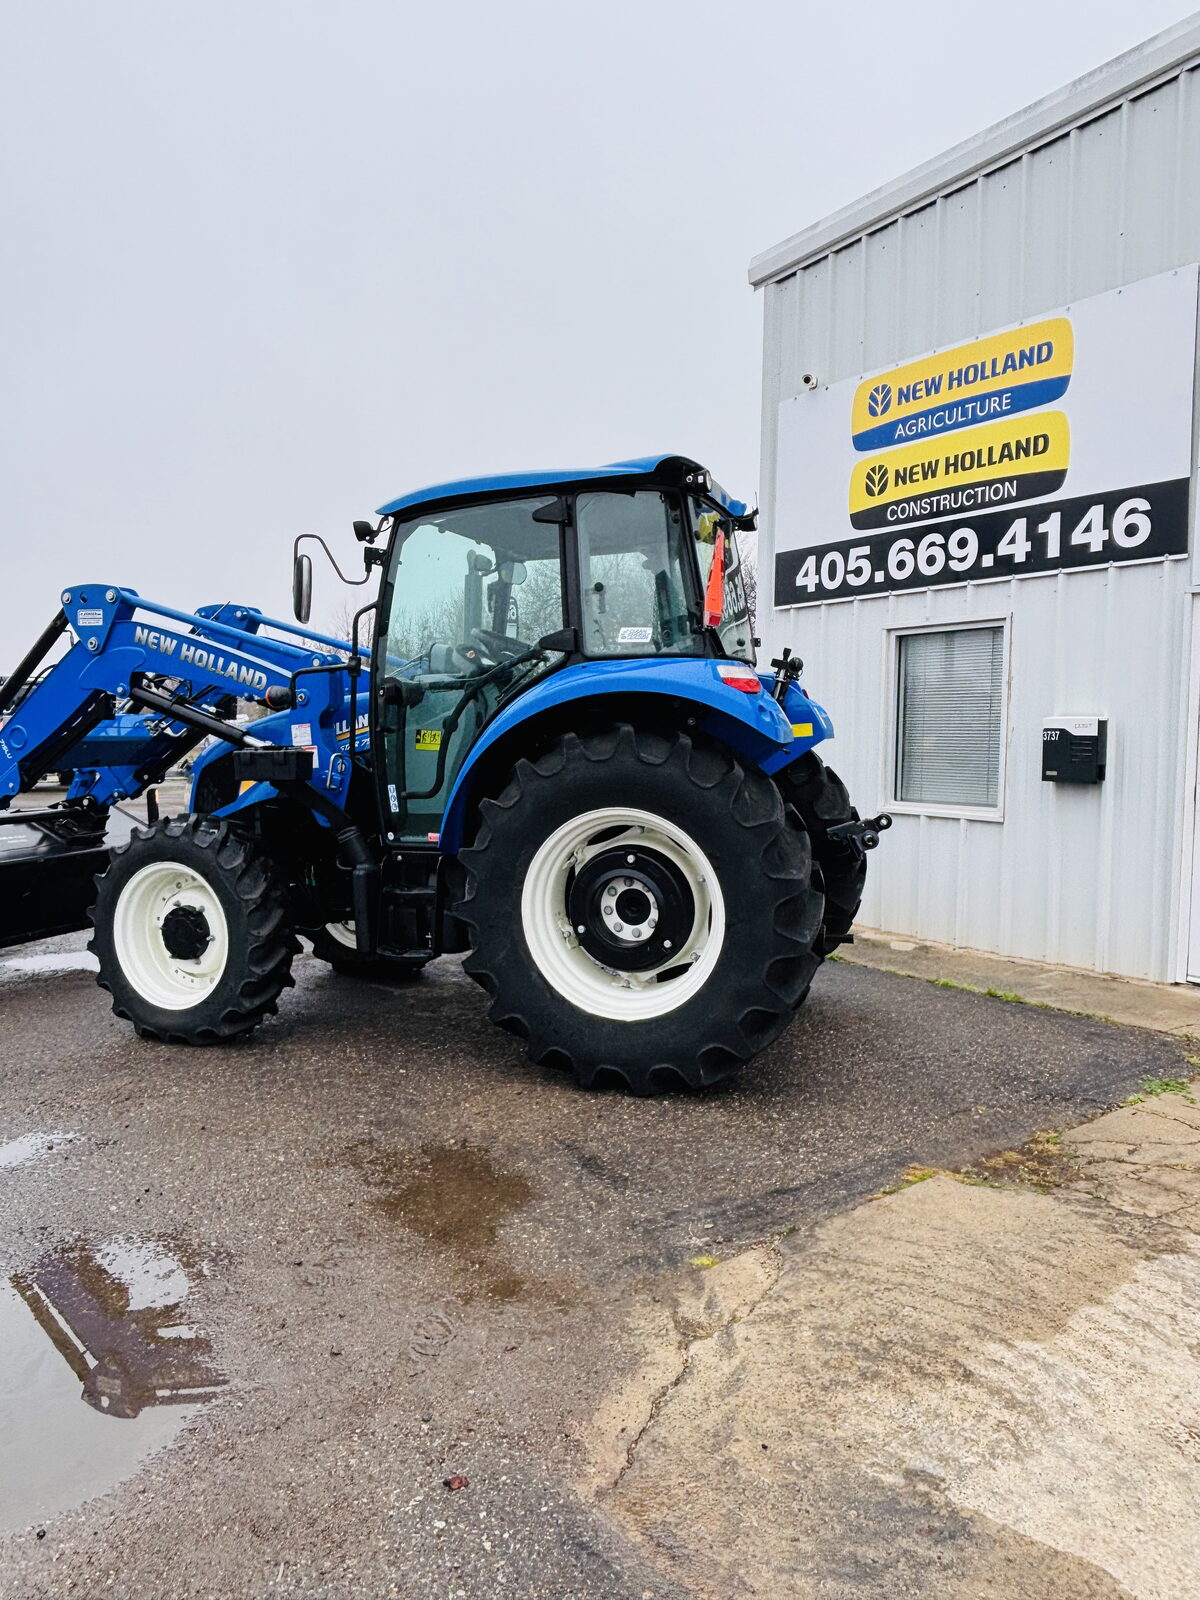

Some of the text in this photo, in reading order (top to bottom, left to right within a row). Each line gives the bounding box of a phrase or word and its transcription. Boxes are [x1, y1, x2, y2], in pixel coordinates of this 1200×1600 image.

[896, 340, 1054, 406] NEW HOLLAND
[894, 393, 1012, 440] AGRICULTURE
[894, 433, 1050, 487] NEW HOLLAND
[886, 480, 1017, 522] CONSTRUCTION
[795, 498, 1152, 593] 405.669.4146
[134, 626, 268, 690] NEW HOLLAND
[1043, 731, 1060, 741] 3737
